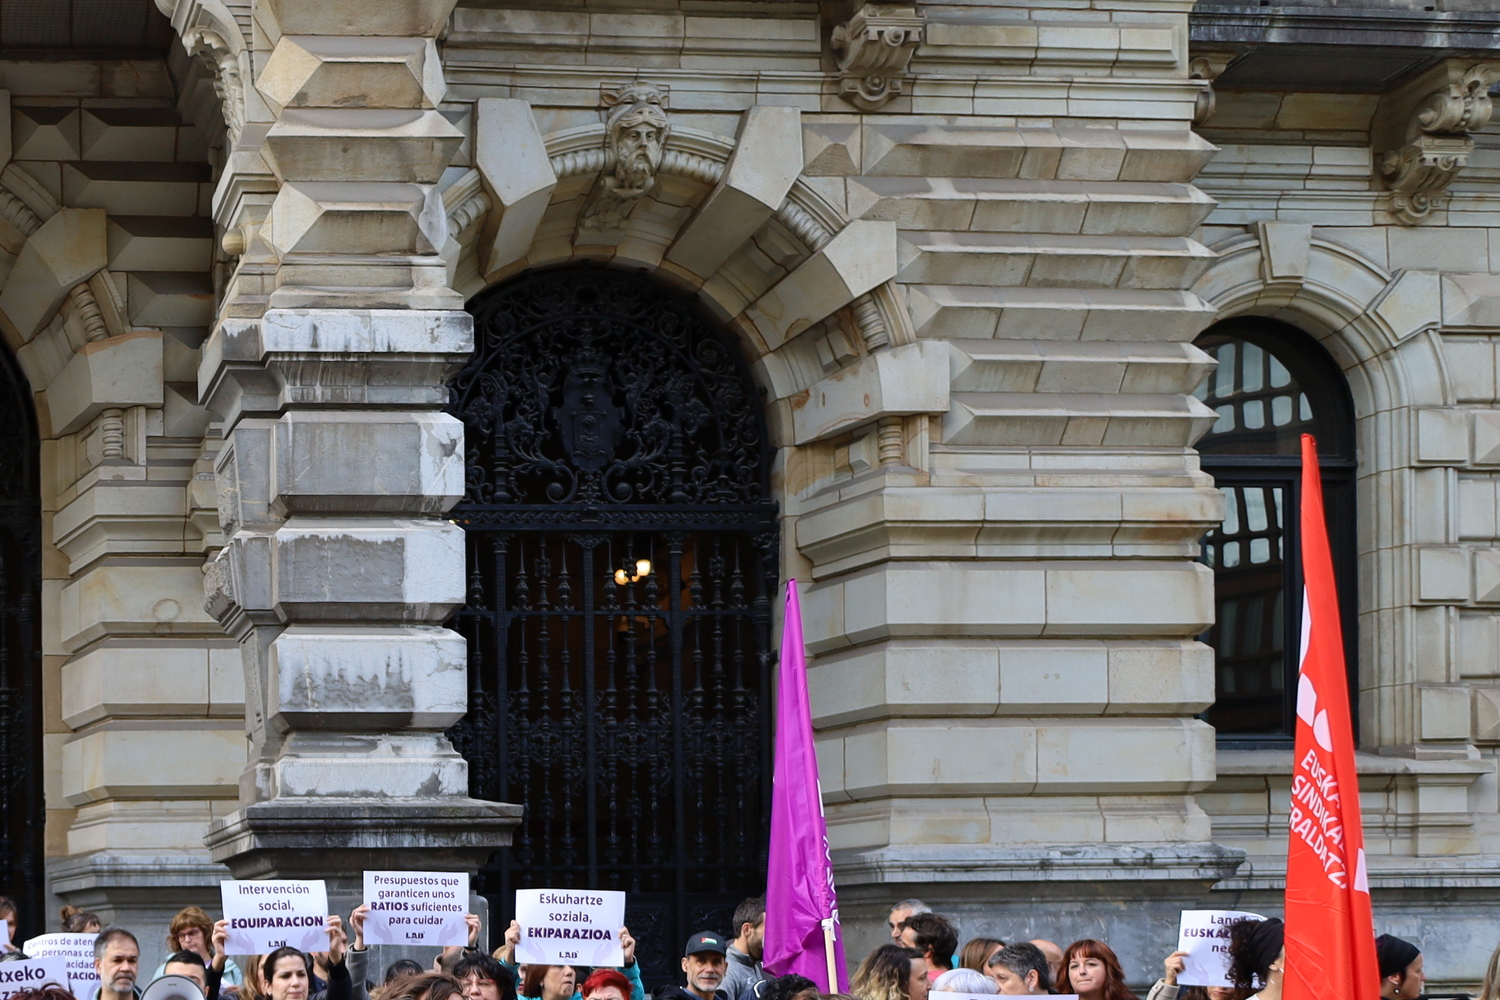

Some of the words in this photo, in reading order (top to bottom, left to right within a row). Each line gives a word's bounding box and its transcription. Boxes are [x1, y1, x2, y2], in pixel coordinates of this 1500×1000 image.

[1291, 774, 1345, 853] SINDIKA
[374, 875, 439, 887] Presupuestos
[441, 878, 459, 887] que
[239, 884, 309, 895] Intervención
[378, 889, 429, 899] garanticen
[432, 890, 455, 898] unos
[539, 893, 603, 905] Eskuhartze
[259, 900, 294, 911] social,
[371, 902, 409, 911] RATIOS
[411, 902, 462, 912] suficientes
[231, 916, 324, 929] EQUIPARACION
[388, 916, 411, 926] para
[413, 915, 443, 925] cuidar
[549, 911, 592, 924] soziala,
[405, 931, 425, 939] LAB
[528, 927, 612, 940] EKIPARAZIOA
[60, 937, 71, 945] de
[73, 938, 93, 946] aten
[41, 950, 82, 958] personas
